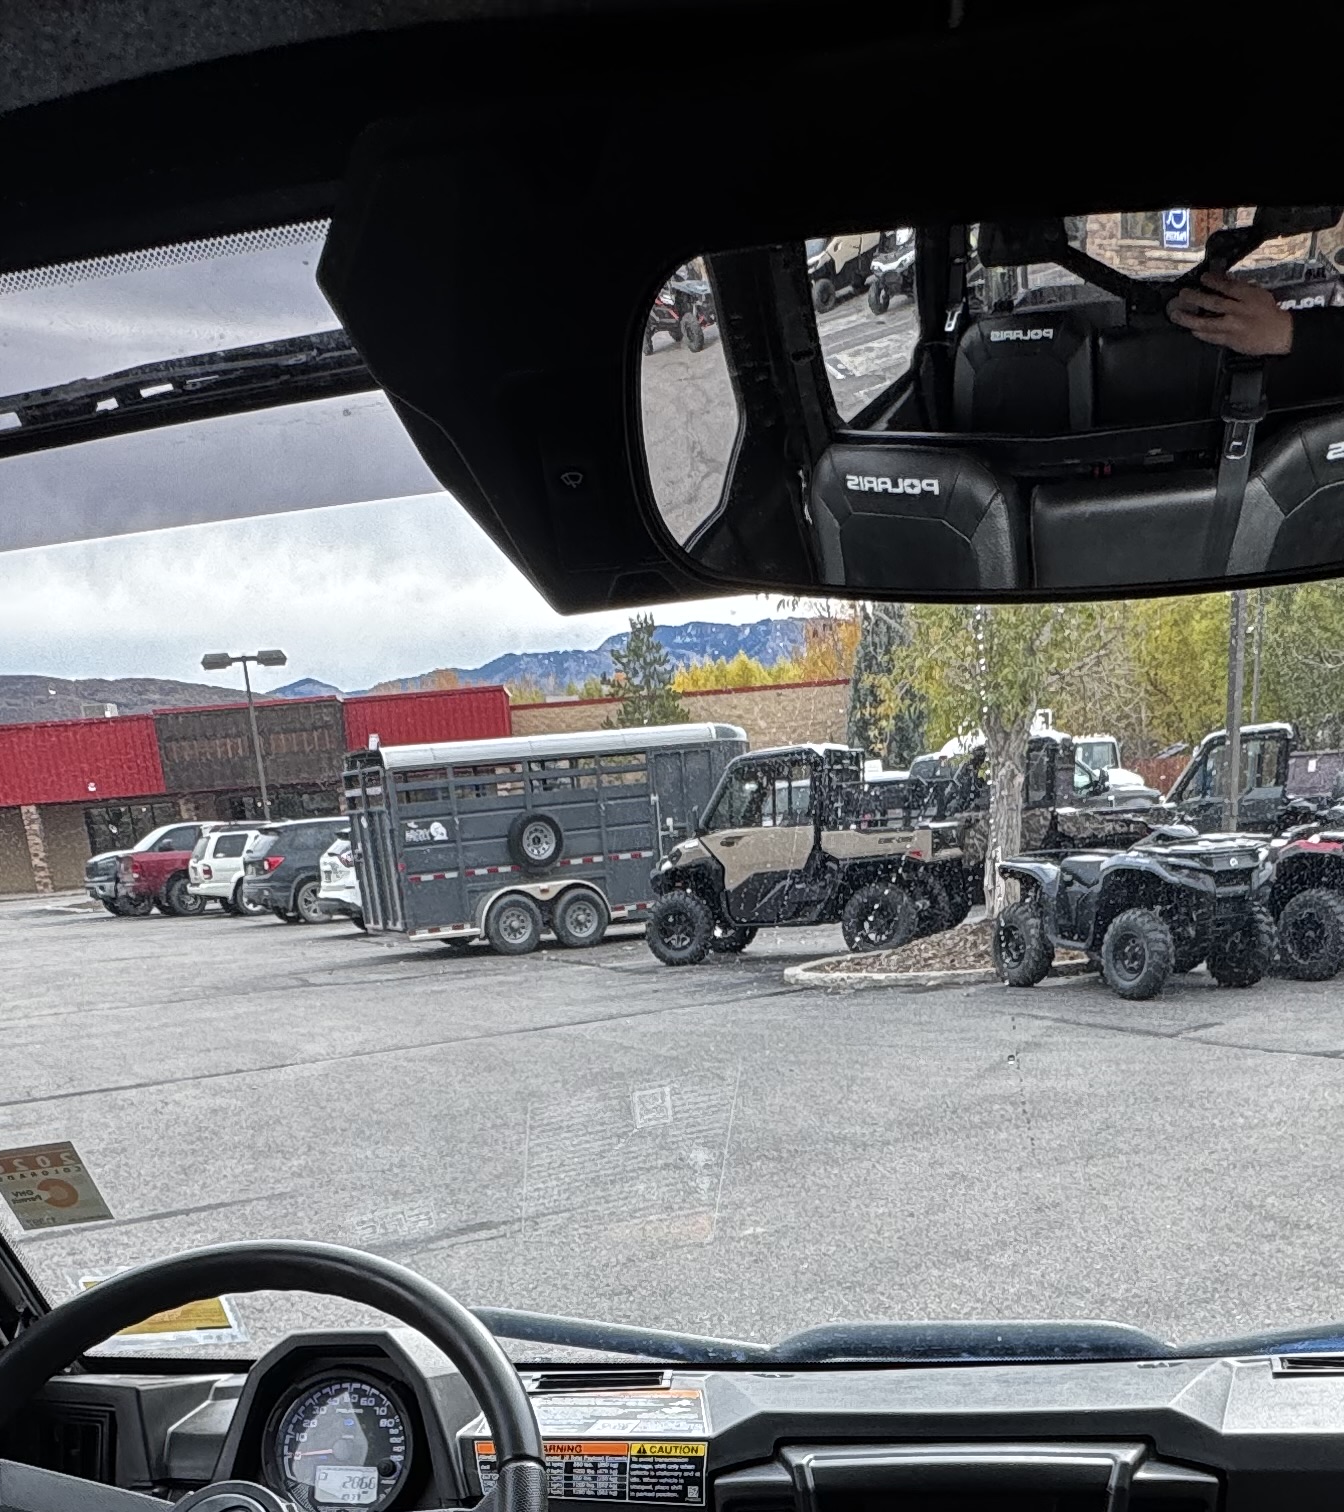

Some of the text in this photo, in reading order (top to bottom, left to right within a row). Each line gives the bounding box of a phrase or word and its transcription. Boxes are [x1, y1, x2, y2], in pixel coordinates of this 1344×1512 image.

[360, 1397, 376, 1406] 60
[313, 1406, 327, 1415] 30
[373, 1407, 387, 1415] 70
[303, 1419, 318, 1428] 20
[379, 1419, 395, 1427] 80
[296, 1432, 308, 1442] 10
[543, 1444, 583, 1454] ARNING
[649, 1445, 700, 1455] CAUTION
